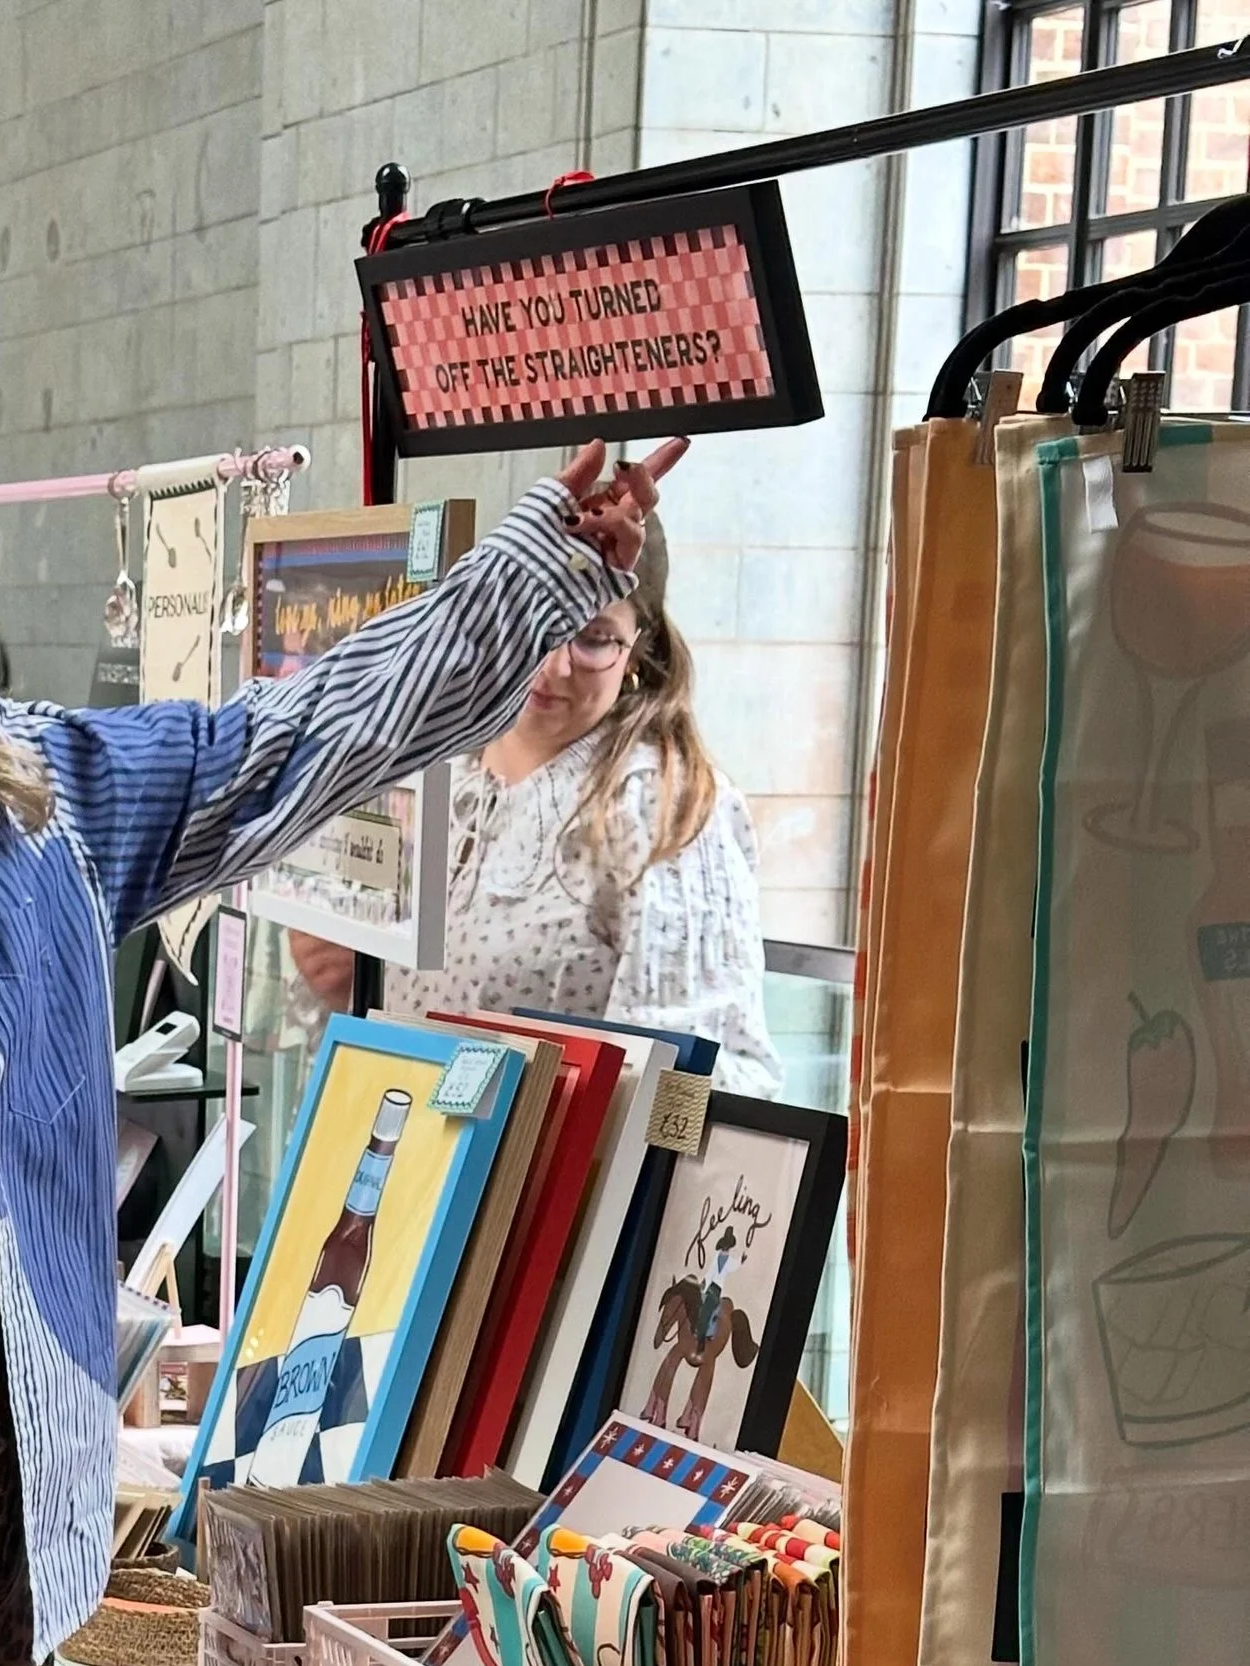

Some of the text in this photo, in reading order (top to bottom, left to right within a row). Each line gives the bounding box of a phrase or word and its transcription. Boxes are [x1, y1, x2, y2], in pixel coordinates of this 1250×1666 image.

[461, 278, 661, 337] HAVE YOU TURNED
[435, 329, 721, 394] OFF THE STRAIGHTENERS?
[685, 1174, 772, 1269] feeling
[274, 1351, 336, 1409] BROWN
[270, 1420, 307, 1442] SAUCE
